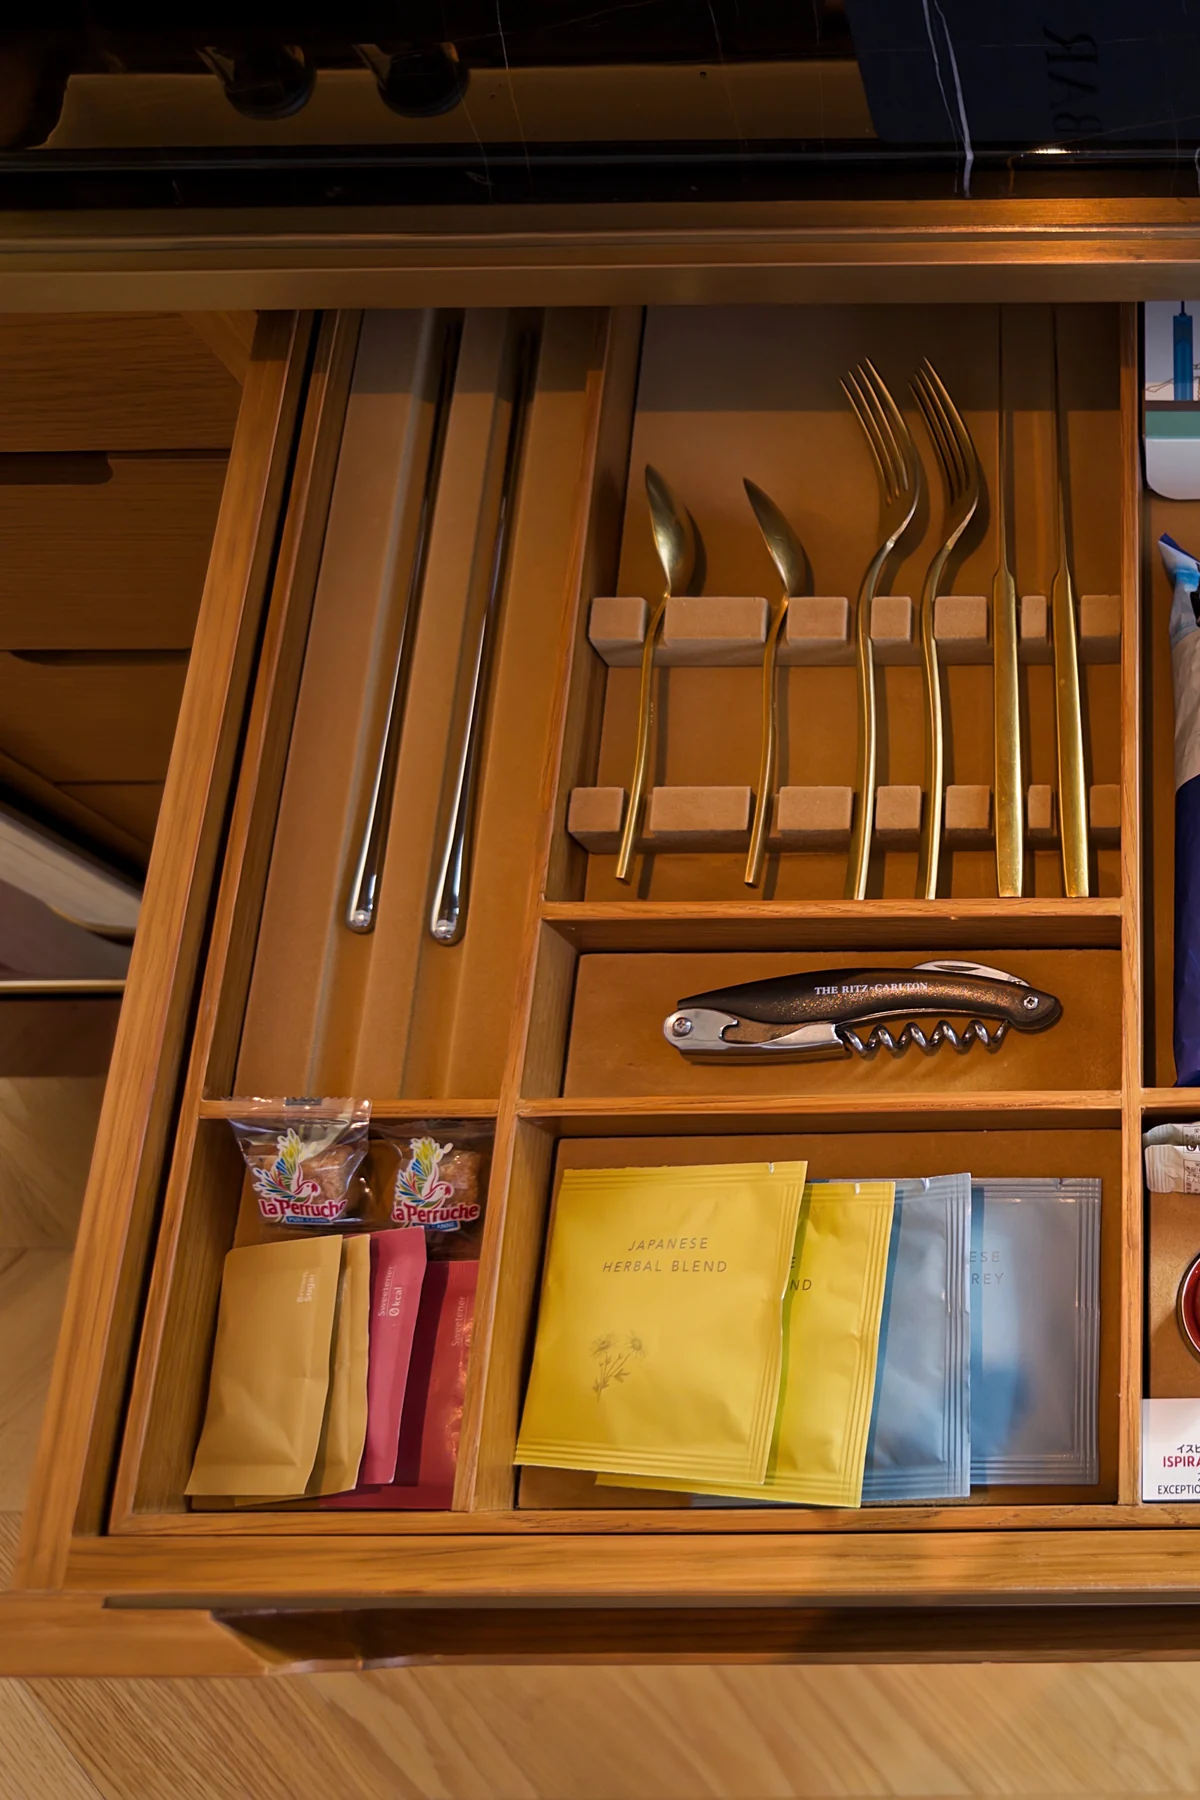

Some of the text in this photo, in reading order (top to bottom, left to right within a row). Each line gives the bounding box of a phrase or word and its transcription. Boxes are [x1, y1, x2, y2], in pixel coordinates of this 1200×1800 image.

[814, 986, 838, 995] THE
[403, 1202, 479, 1222] Perruche
[628, 1237, 709, 1251] JAPANESE
[602, 1260, 728, 1273] HERBAL BLEND
[304, 1274, 316, 1303] Sugar
[378, 1265, 394, 1316] Sweetener
[389, 1286, 403, 1316] 0 kcal
[451, 1296, 466, 1347] Sweetener
